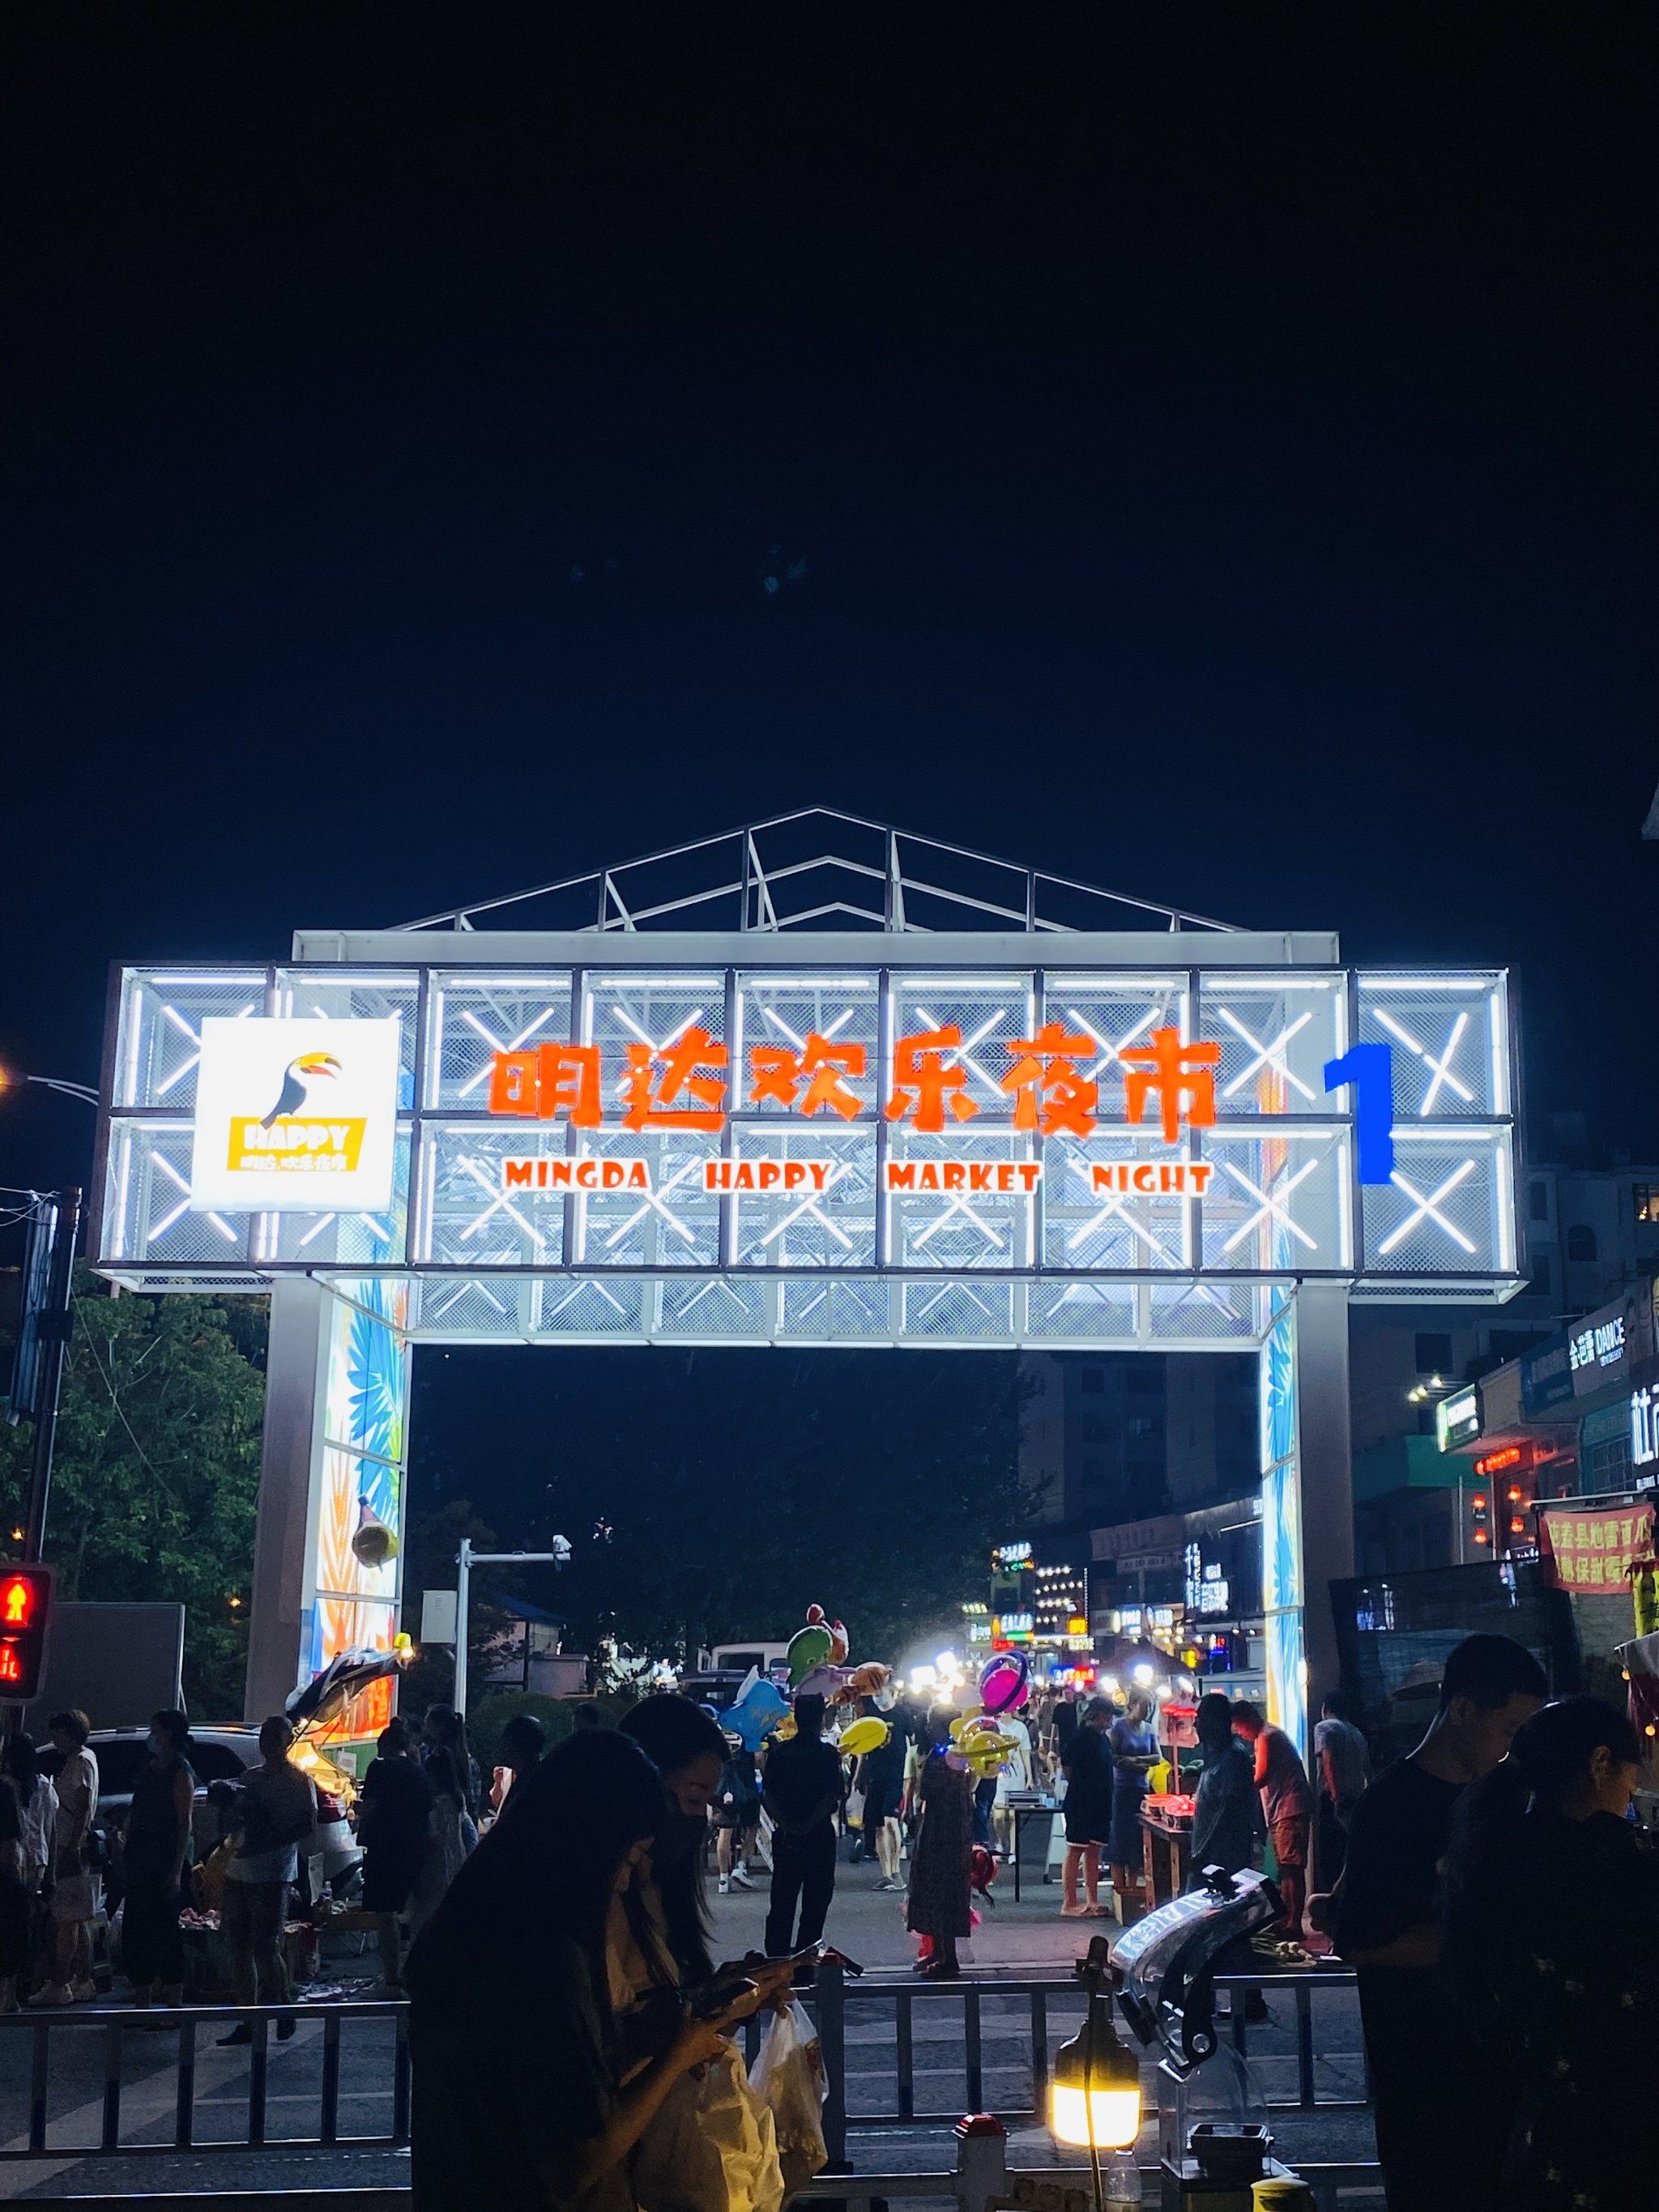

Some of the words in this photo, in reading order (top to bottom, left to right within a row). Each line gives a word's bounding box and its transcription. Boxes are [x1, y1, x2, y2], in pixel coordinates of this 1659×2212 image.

[488, 1024, 1220, 1143] 明达欢乐夜市
[1324, 1042, 1393, 1184] 1
[244, 1124, 350, 1150] HAPPY
[505, 1161, 649, 1188] MINGDA
[706, 1162, 830, 1191] HAPPY
[887, 1163, 1040, 1191] MARKET
[1093, 1165, 1210, 1193] NIGHT
[1595, 1316, 1626, 1355] DANCE
